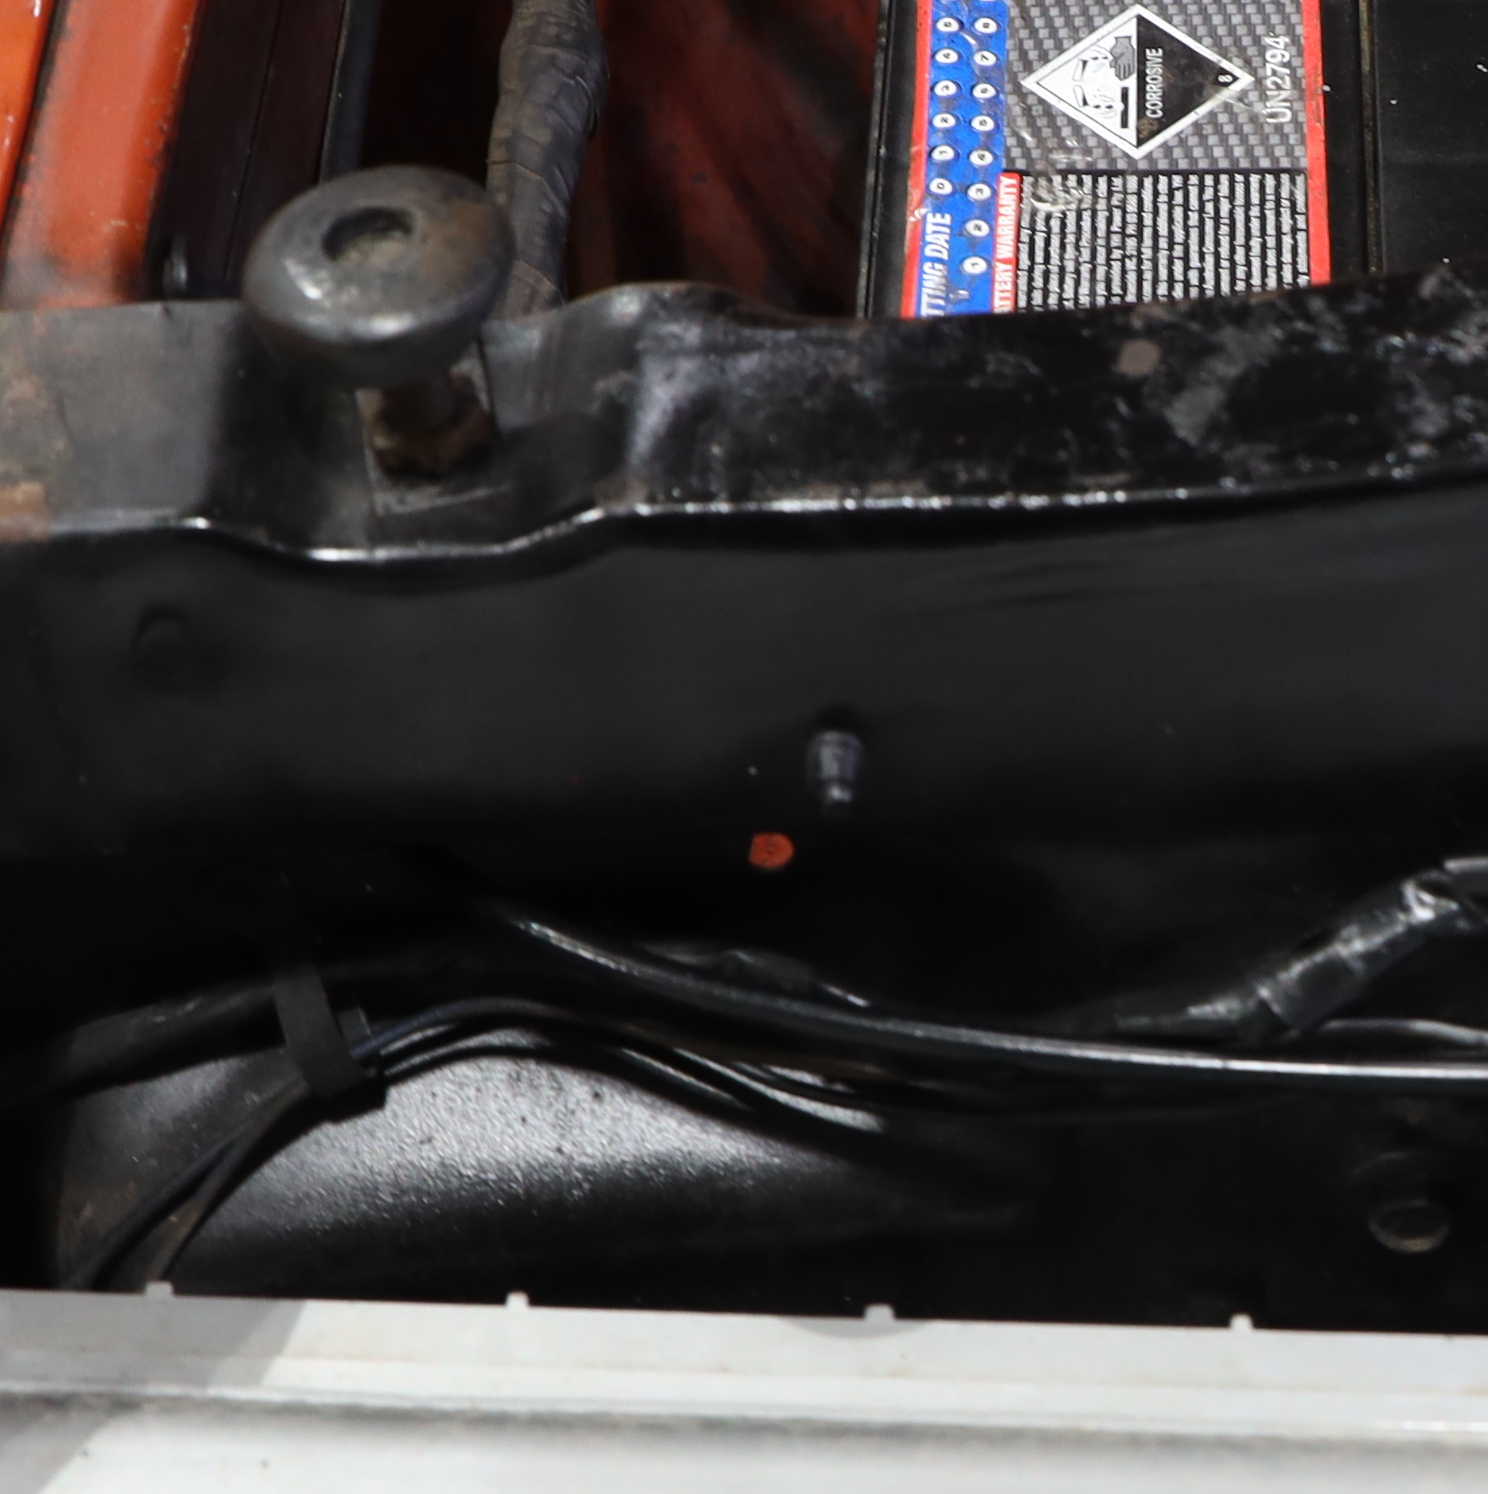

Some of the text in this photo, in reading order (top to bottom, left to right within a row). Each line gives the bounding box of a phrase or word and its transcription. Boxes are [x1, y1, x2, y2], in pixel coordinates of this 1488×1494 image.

[1144, 47, 1164, 119] CORROSIVE
[1217, 74, 1233, 83] 8
[1265, 35, 1292, 124] UN2794
[922, 211, 952, 260] DATE
[992, 175, 1017, 313] ATTERY WARRANTY
[920, 261, 949, 318] TTING
